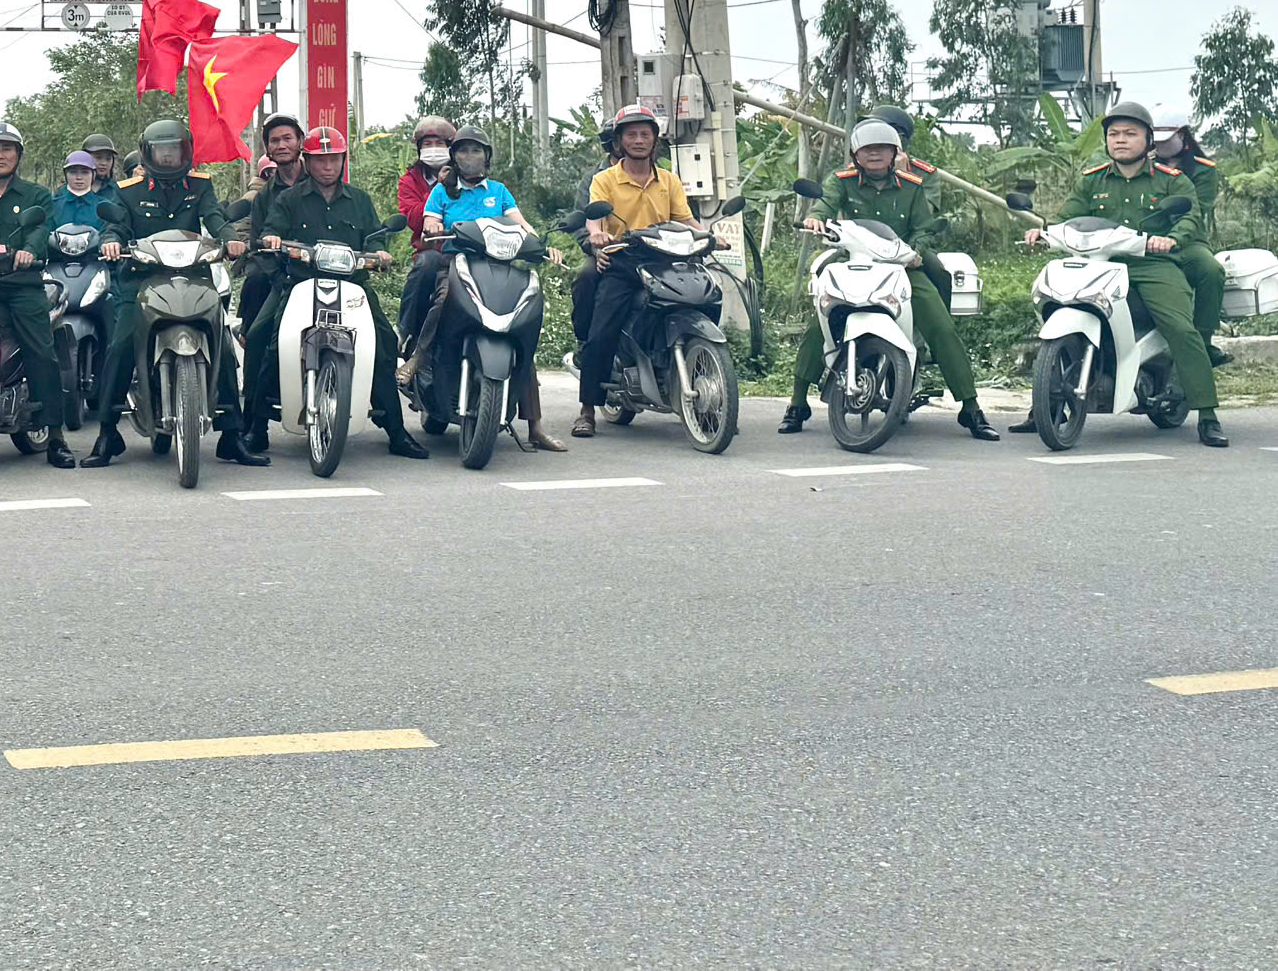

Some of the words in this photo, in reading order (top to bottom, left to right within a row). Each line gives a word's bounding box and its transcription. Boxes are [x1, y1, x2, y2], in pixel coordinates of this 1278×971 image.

[67, 9, 85, 22] 3m
[312, 19, 337, 45] LÒNG
[317, 63, 335, 88] GÌN
[717, 223, 740, 234] VAY
